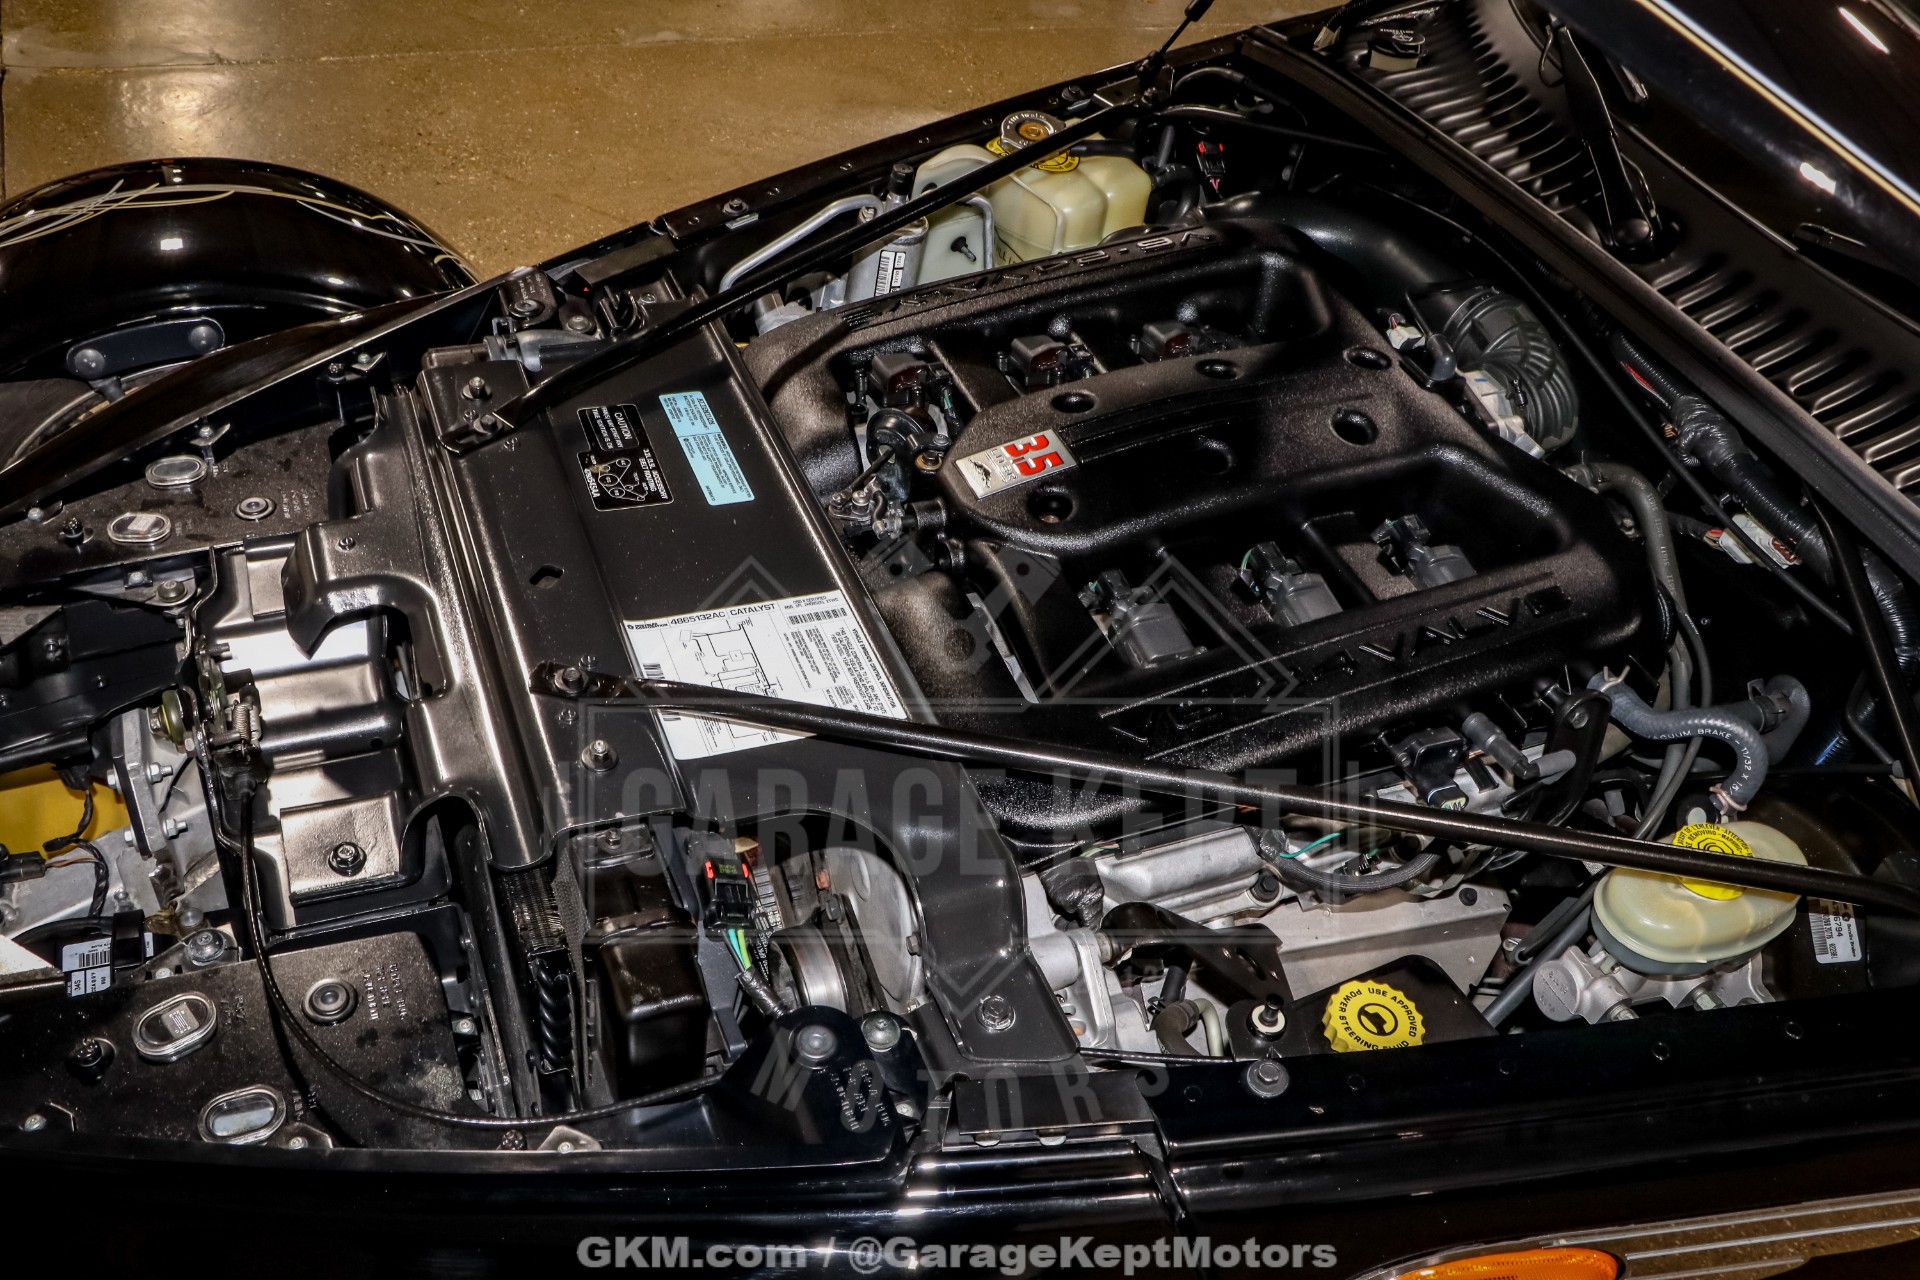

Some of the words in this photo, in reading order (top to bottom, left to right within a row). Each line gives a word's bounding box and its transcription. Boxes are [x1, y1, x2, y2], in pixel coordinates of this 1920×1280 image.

[614, 412, 632, 440] CAUTION
[730, 603, 776, 616] CATALYST
[1698, 728, 1732, 740] BRAKE
[1339, 989, 1363, 1013] POWER
[1368, 987, 1388, 997] USE
[1390, 995, 1418, 1038] APPROVED
[1339, 1015, 1379, 1050] STEERING
